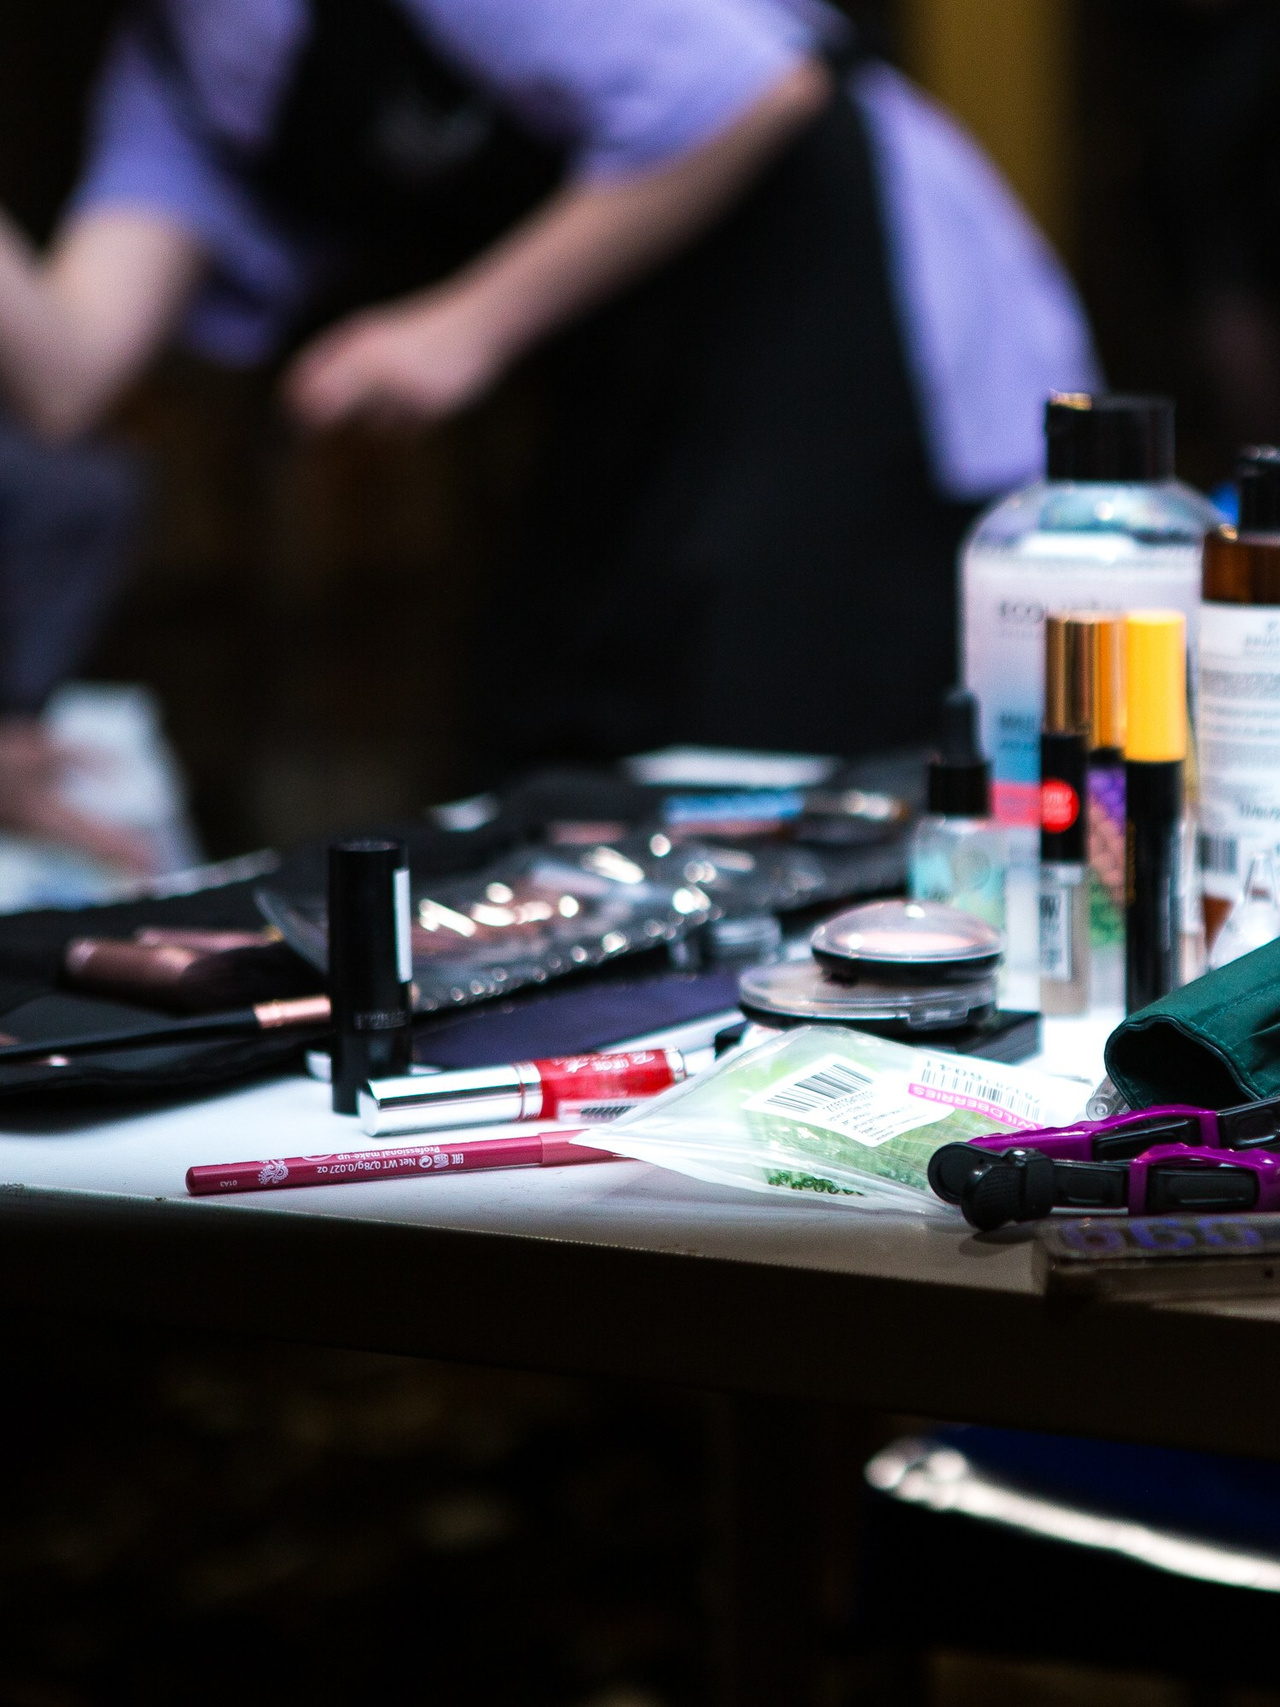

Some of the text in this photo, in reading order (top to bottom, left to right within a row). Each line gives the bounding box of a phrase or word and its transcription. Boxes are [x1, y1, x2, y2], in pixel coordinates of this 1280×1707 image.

[913, 1086, 1038, 1131] WILDBERRIES
[337, 1145, 441, 1160] Professional make-up
[382, 1159, 399, 1169] WT
[399, 1157, 417, 1168] Net
[317, 1166, 328, 1174] oz
[219, 1179, 238, 1189] 01A3
